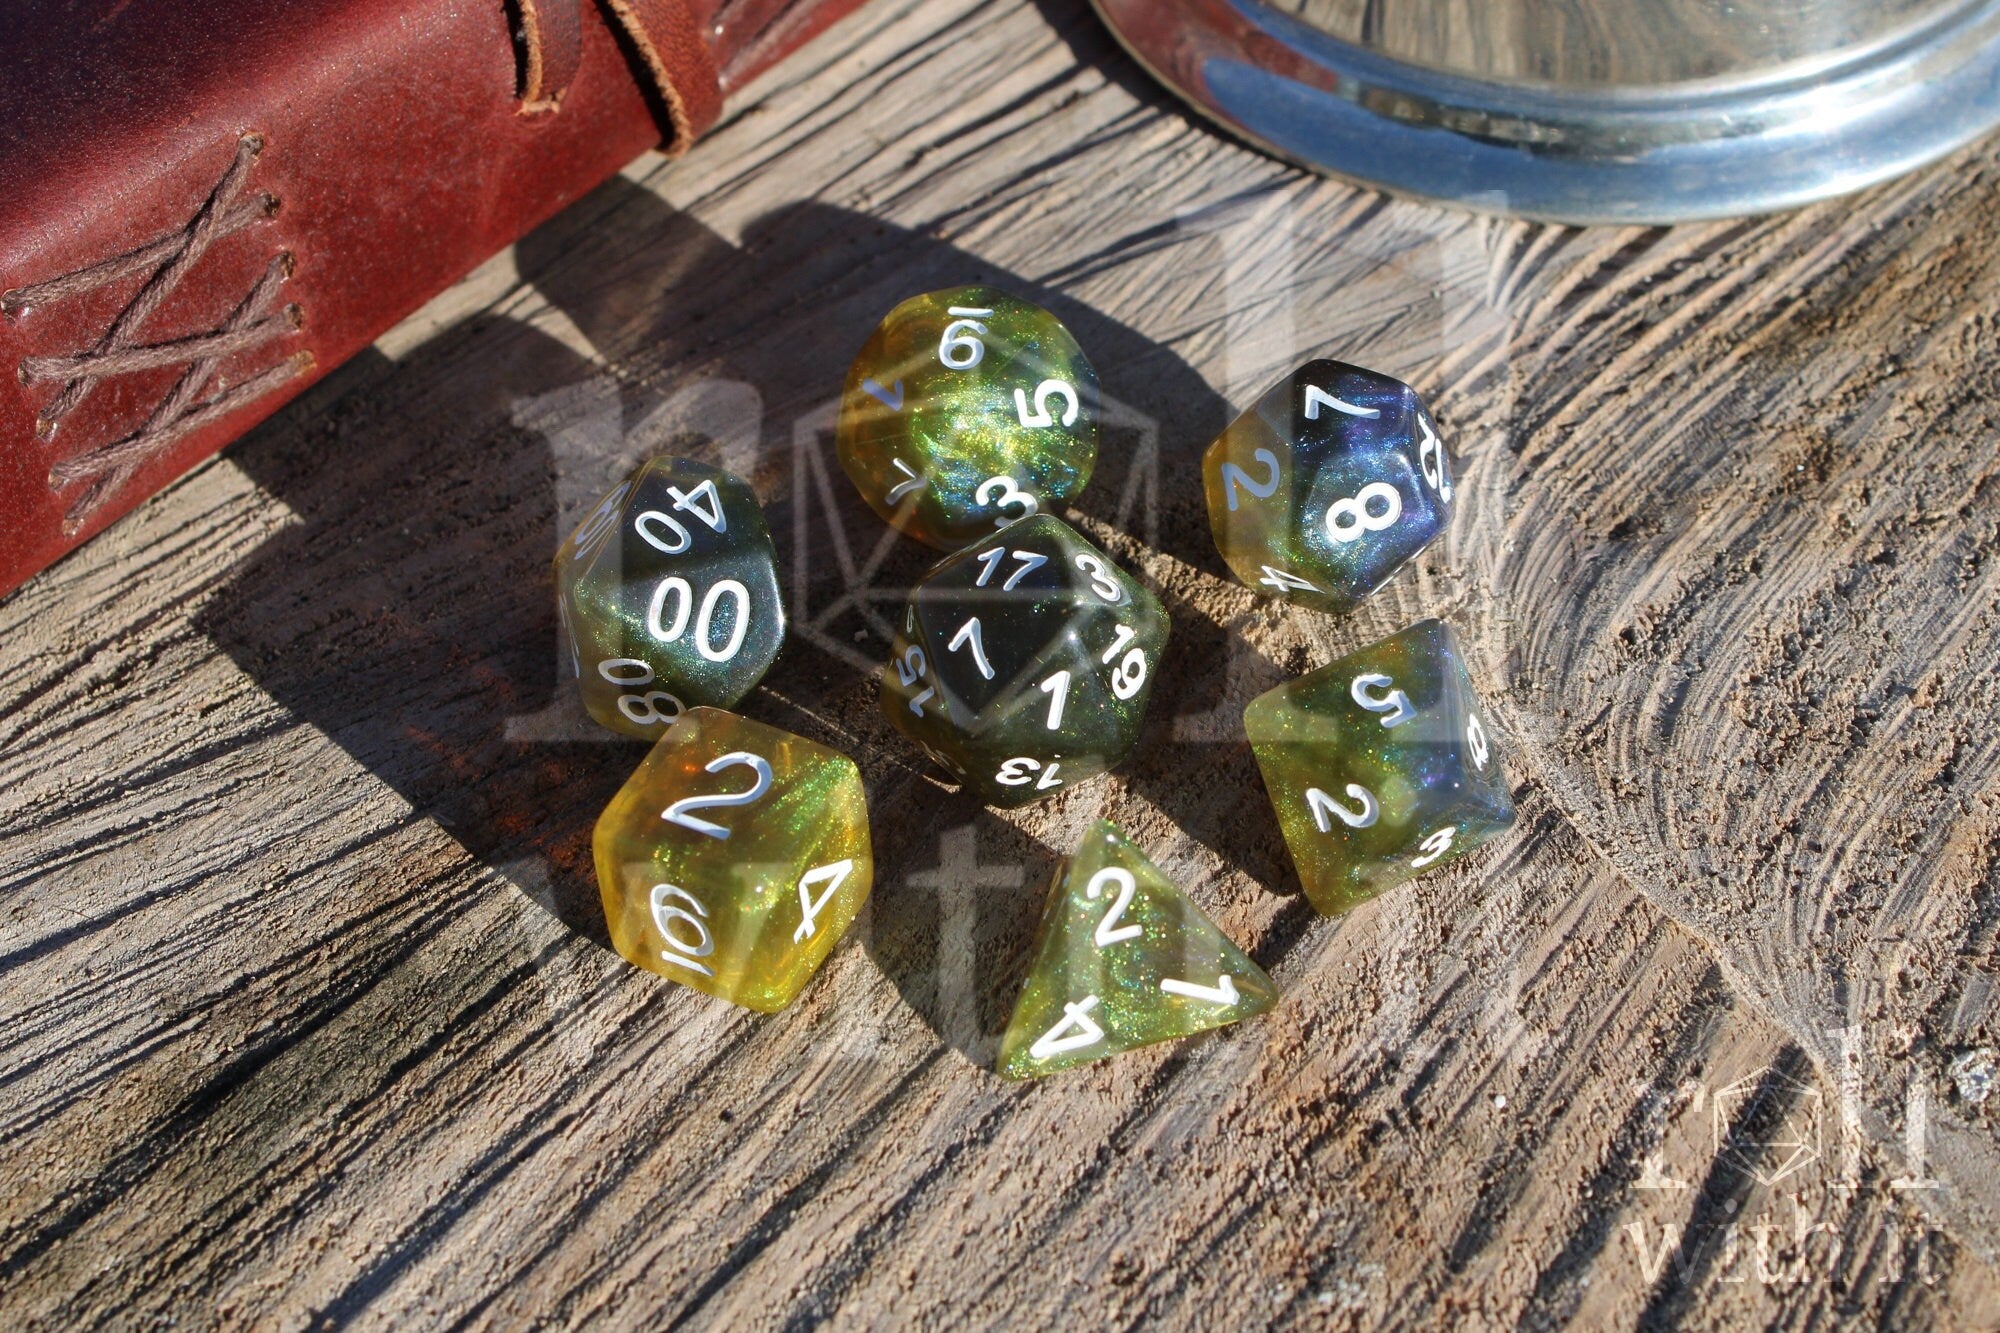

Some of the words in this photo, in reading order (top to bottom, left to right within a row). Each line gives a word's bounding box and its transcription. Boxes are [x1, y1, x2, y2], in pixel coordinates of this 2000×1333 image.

[1013, 378, 1079, 428] 5
[1304, 384, 1381, 420] 7
[975, 475, 1039, 529] 3
[1221, 447, 1281, 512] 2
[634, 479, 727, 554] 40
[1325, 481, 1403, 543] 8
[975, 546, 1049, 592] 17
[1074, 553, 1121, 602] 3
[1258, 565, 1327, 594] 4
[648, 576, 750, 662] 00
[597, 657, 688, 725] 80
[896, 644, 936, 718] 15
[1101, 623, 1148, 700] 19
[1040, 670, 1071, 730] 1
[1350, 672, 1418, 728] 5
[660, 751, 774, 841] 2
[994, 754, 1064, 791] 13
[1304, 783, 1380, 833] 2
[1410, 826, 1457, 868] 3
[649, 883, 716, 978] 6
[792, 858, 854, 945] 4
[1086, 866, 1144, 947] 2
[1160, 974, 1242, 1007] 1
[1029, 994, 1106, 1060] 4
